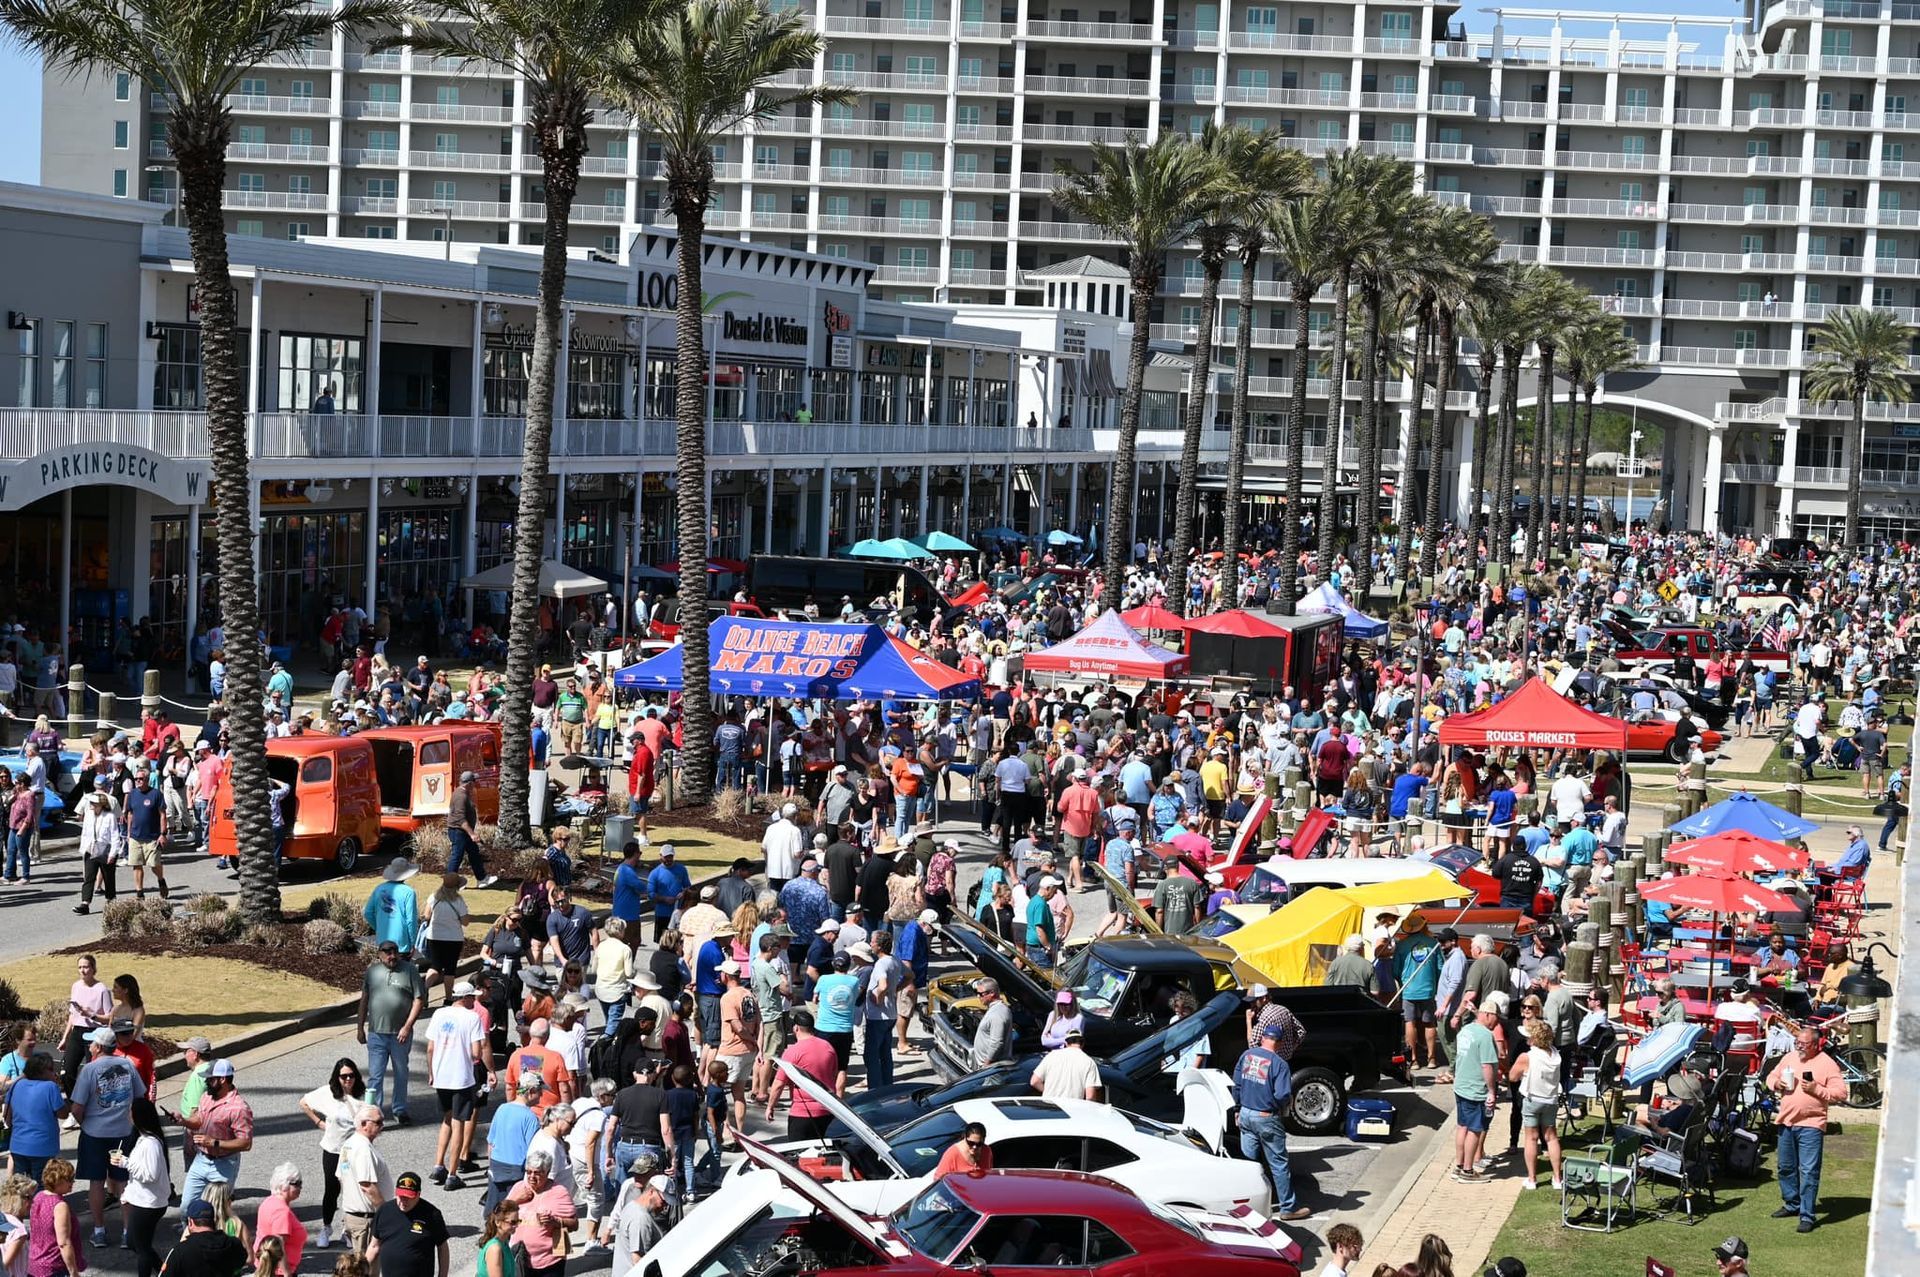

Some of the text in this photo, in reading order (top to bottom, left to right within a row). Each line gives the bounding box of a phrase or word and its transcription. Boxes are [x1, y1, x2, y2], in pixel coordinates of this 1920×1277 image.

[573, 328, 619, 352] Showroom
[723, 310, 762, 342] Dental
[763, 316, 774, 343] &
[774, 316, 808, 346] Vision
[41, 452, 159, 485] PARKING DECK
[186, 472, 200, 496] W
[724, 625, 866, 656] ORANGE BEACH
[712, 650, 858, 678] MAKOS
[1069, 660, 1118, 672] Bug Us Anytime!
[1486, 730, 1576, 744] ROUSES MARKETS
